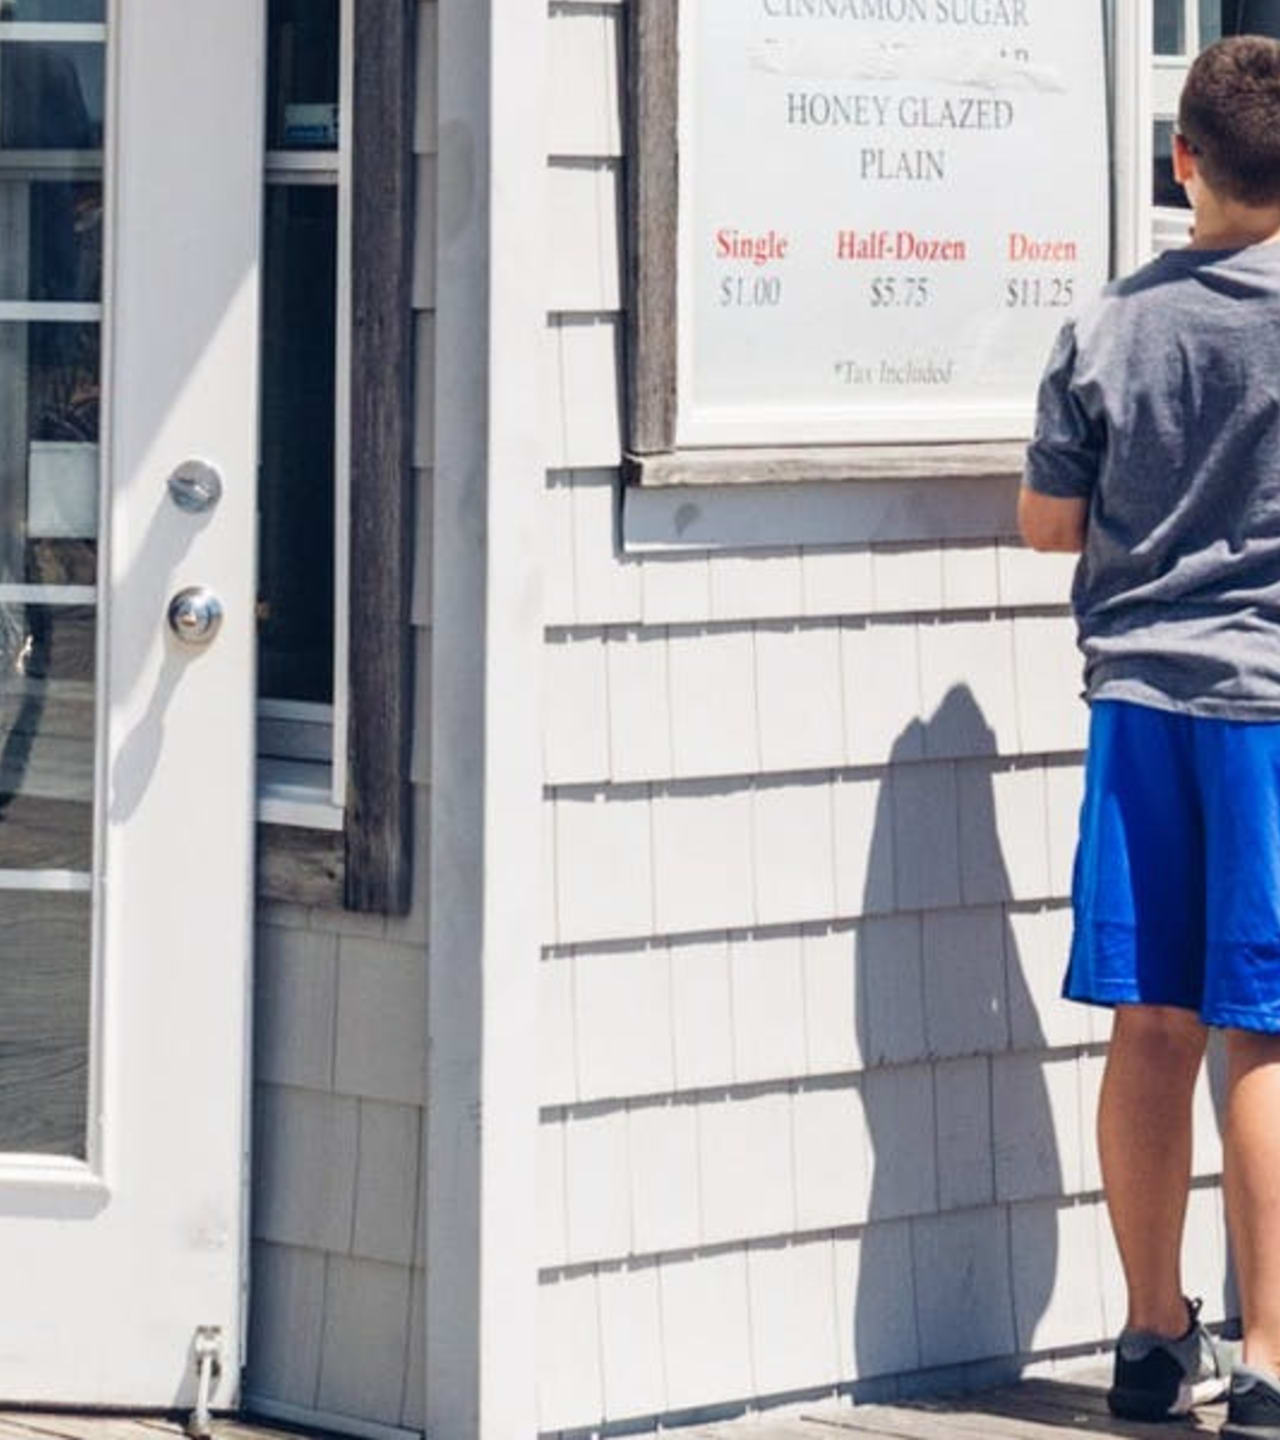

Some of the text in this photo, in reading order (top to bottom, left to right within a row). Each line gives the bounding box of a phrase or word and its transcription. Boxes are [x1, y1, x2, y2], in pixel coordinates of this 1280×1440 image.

[786, 92, 1015, 130] HONEY GLAZED
[860, 148, 946, 181] PLAIN
[715, 228, 1078, 266] Single Half-Dozen Dozen
[719, 275, 1074, 309] $1.00 $5.75 $11.25
